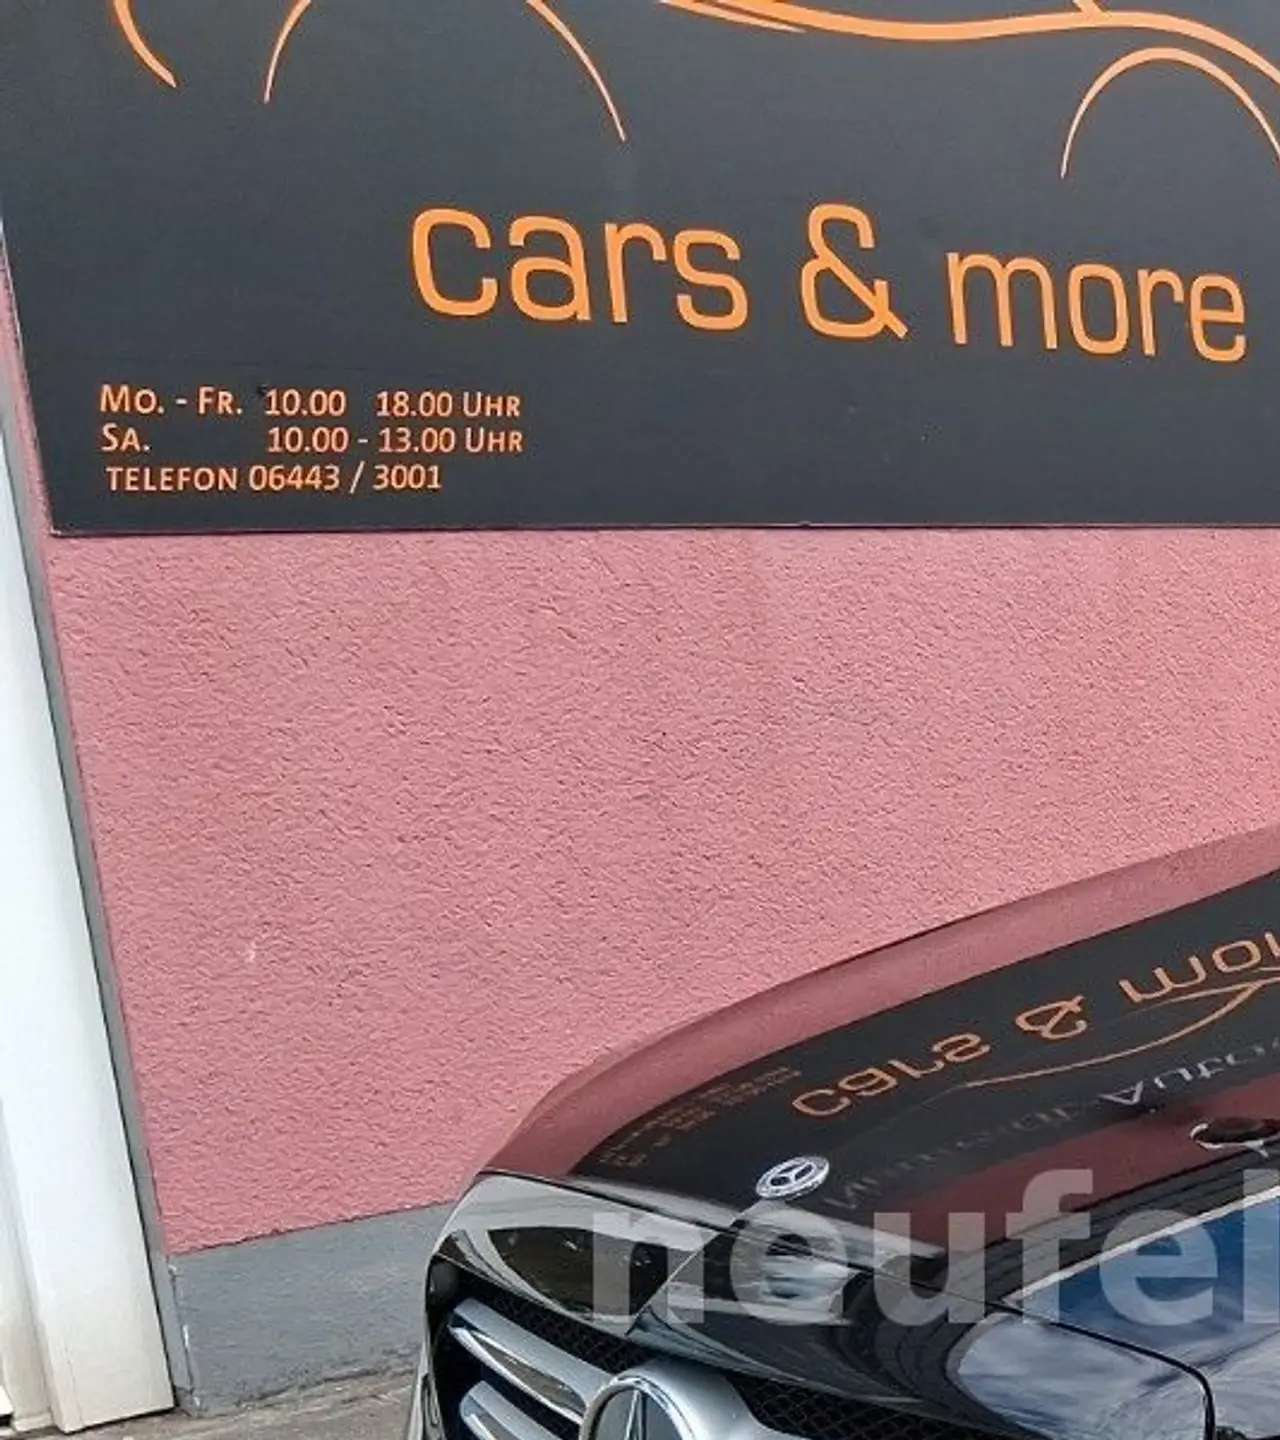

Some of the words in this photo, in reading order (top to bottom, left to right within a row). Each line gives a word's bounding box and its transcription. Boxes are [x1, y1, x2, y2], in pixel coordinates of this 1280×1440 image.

[410, 206, 751, 334] cars
[800, 203, 909, 342] &
[945, 252, 1248, 364] more
[263, 389, 347, 417] 10.00
[375, 390, 454, 418] 18.00
[267, 425, 350, 453] 10.00
[378, 425, 456, 453] 13.00
[105, 465, 238, 493] TELEFON
[249, 464, 341, 491] 06443
[349, 460, 366, 494] /
[373, 463, 442, 490] 3001
